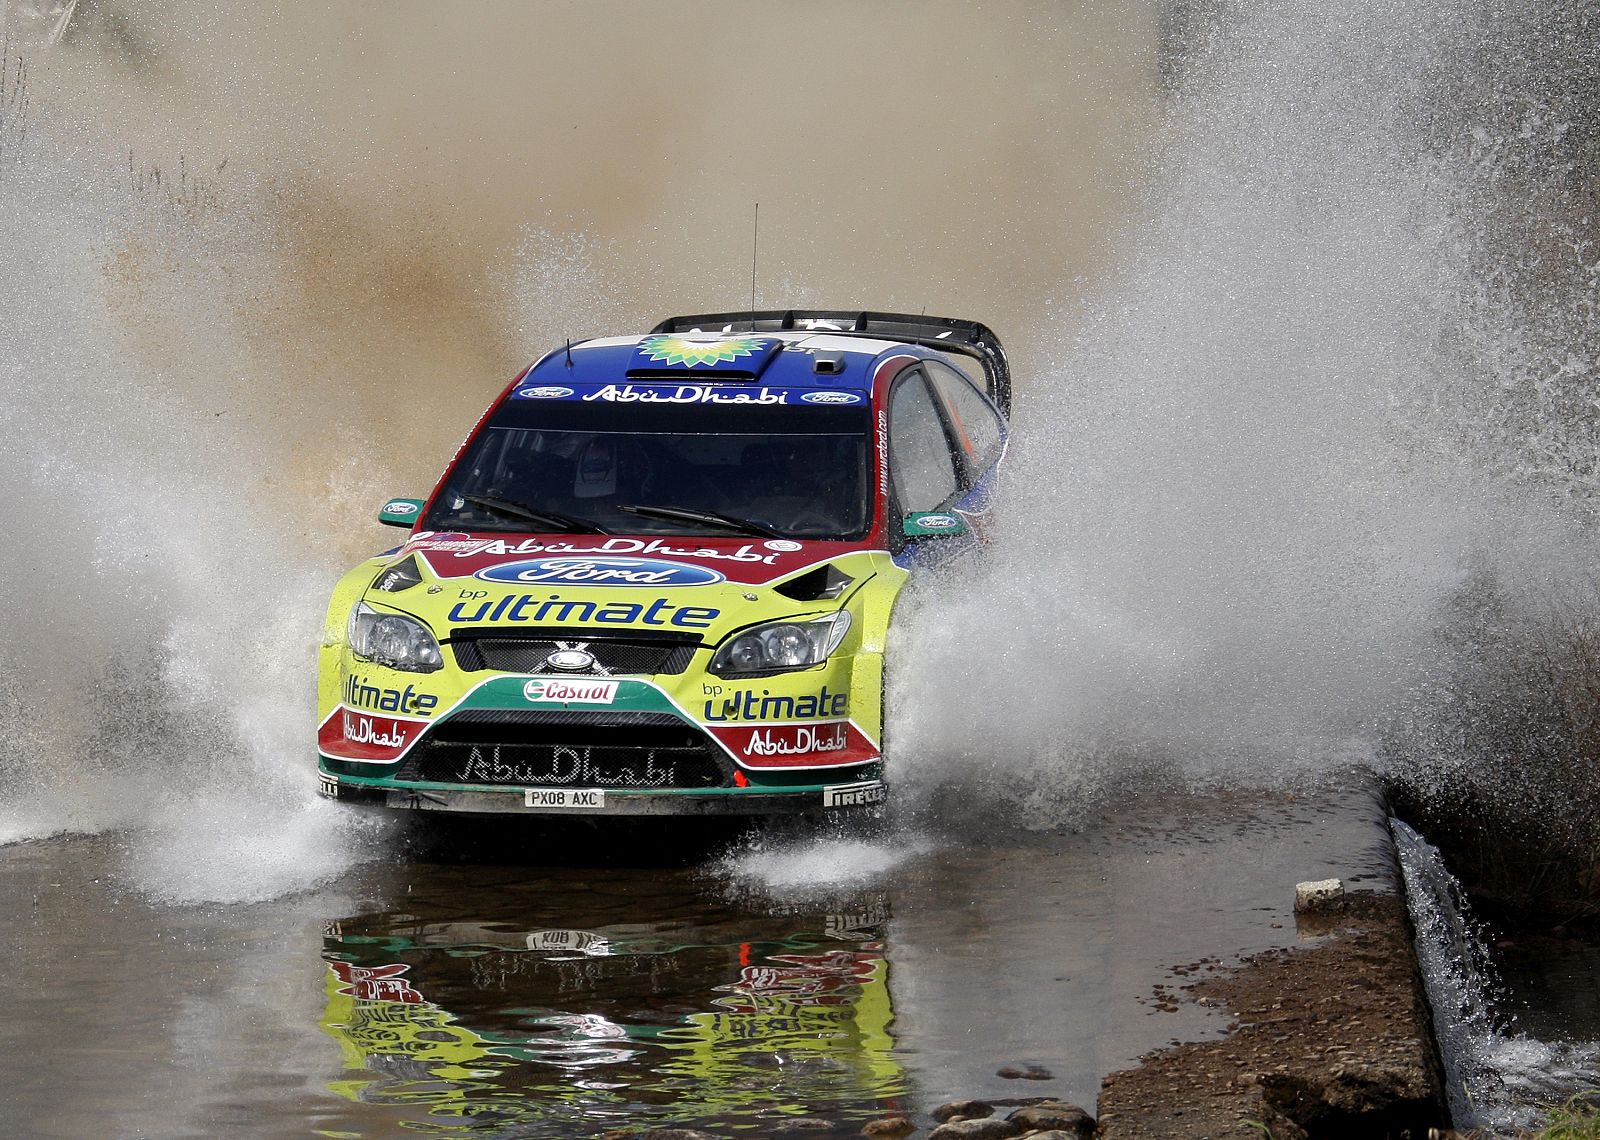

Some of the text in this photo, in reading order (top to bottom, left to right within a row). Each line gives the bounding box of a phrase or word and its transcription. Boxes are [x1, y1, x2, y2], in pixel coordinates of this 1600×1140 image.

[526, 387, 566, 397] Ford
[811, 392, 851, 403] Ford
[387, 503, 412, 513] Ford
[923, 517, 950, 526] Ford
[517, 560, 681, 584] Ford
[459, 589, 488, 600] bp
[448, 595, 721, 627] ultimate
[545, 682, 611, 700] Castrol
[702, 683, 723, 697] bp
[704, 686, 848, 721] ultimate
[531, 791, 598, 806] PX08 AXC
